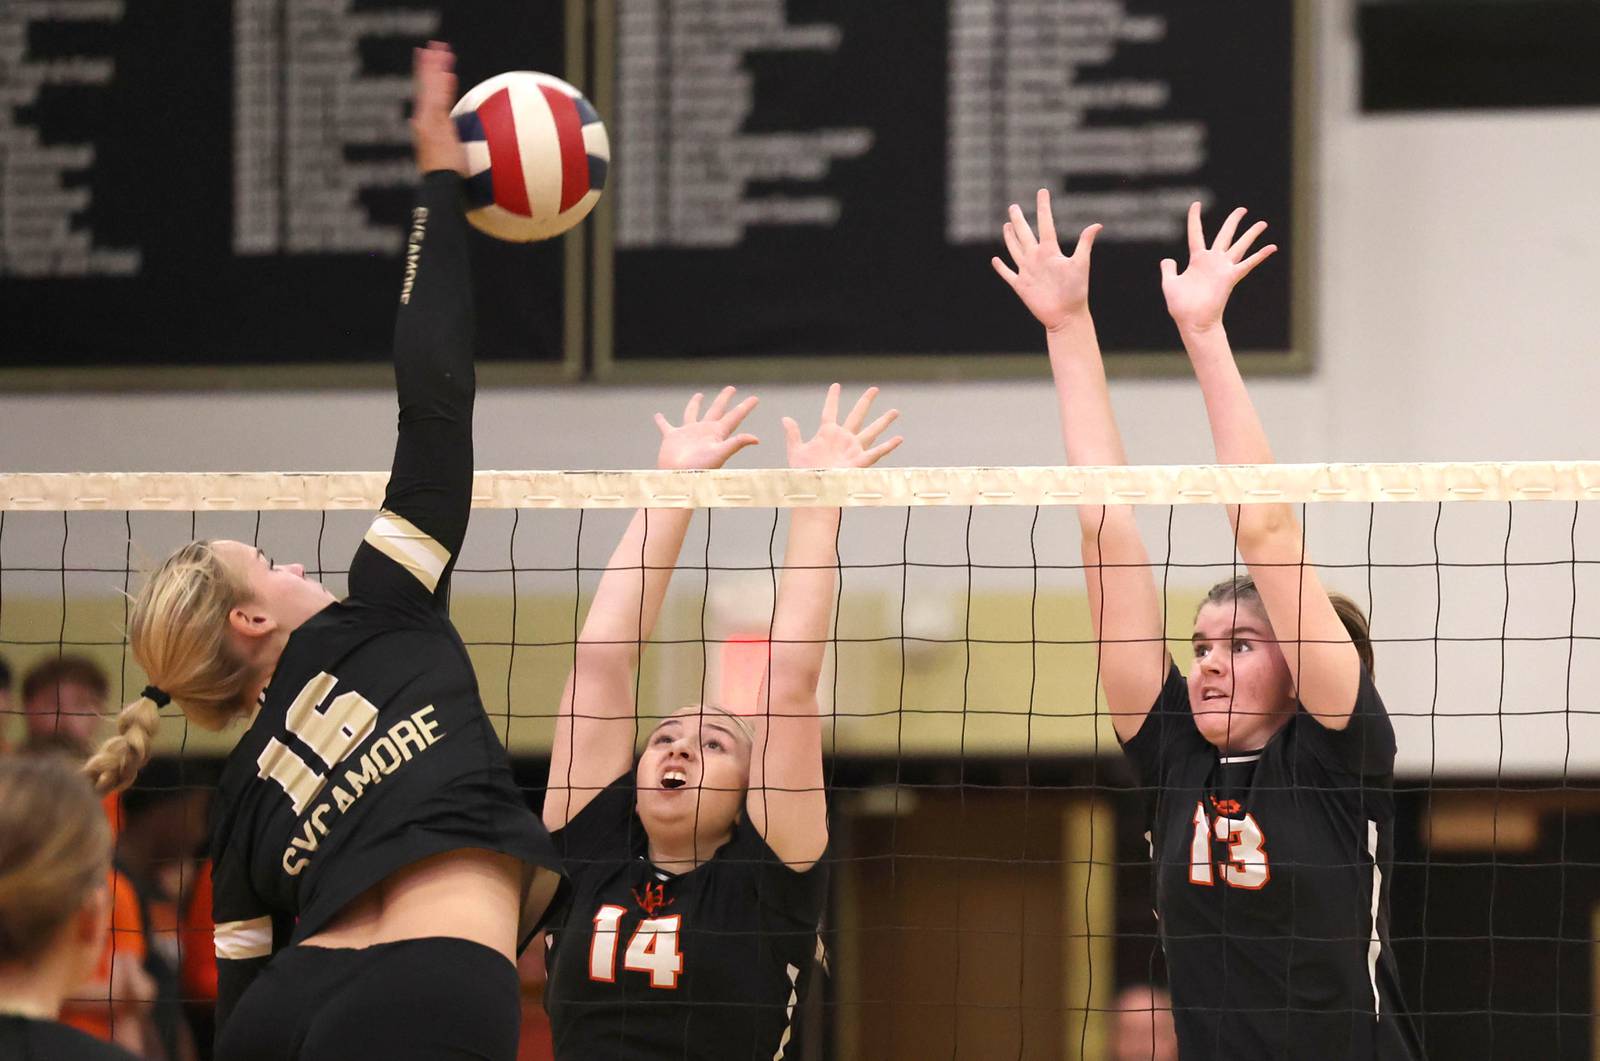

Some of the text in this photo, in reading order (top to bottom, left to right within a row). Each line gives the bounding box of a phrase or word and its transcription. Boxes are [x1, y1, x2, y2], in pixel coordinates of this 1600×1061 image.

[257, 671, 379, 816] 16
[282, 704, 447, 875] SYCAMORE
[1189, 800, 1271, 890] 13
[588, 904, 684, 989] 14
